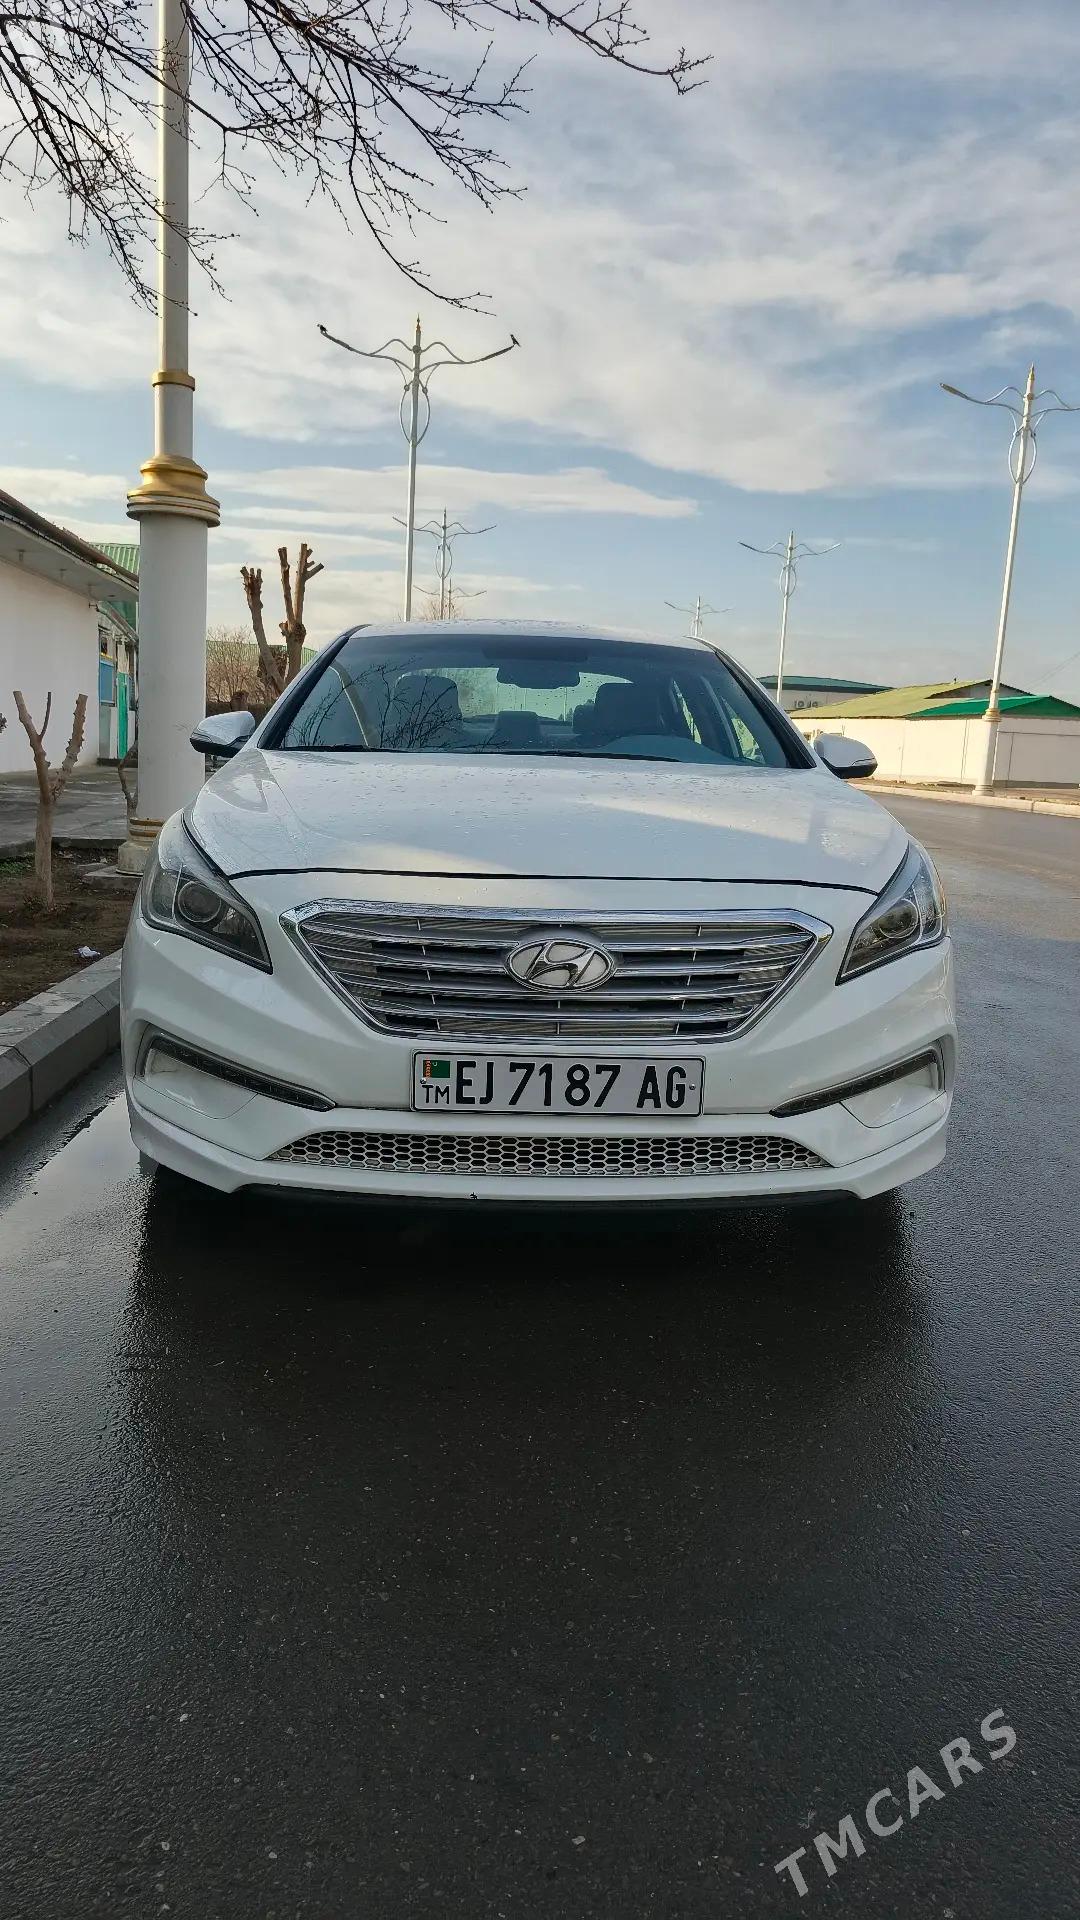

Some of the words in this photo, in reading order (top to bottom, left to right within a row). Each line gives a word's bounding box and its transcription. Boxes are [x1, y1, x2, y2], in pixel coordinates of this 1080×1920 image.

[421, 1084, 450, 1105] TM
[456, 1060, 494, 1105] EJ
[508, 1061, 621, 1108] 7187
[636, 1065, 687, 1109] AG
